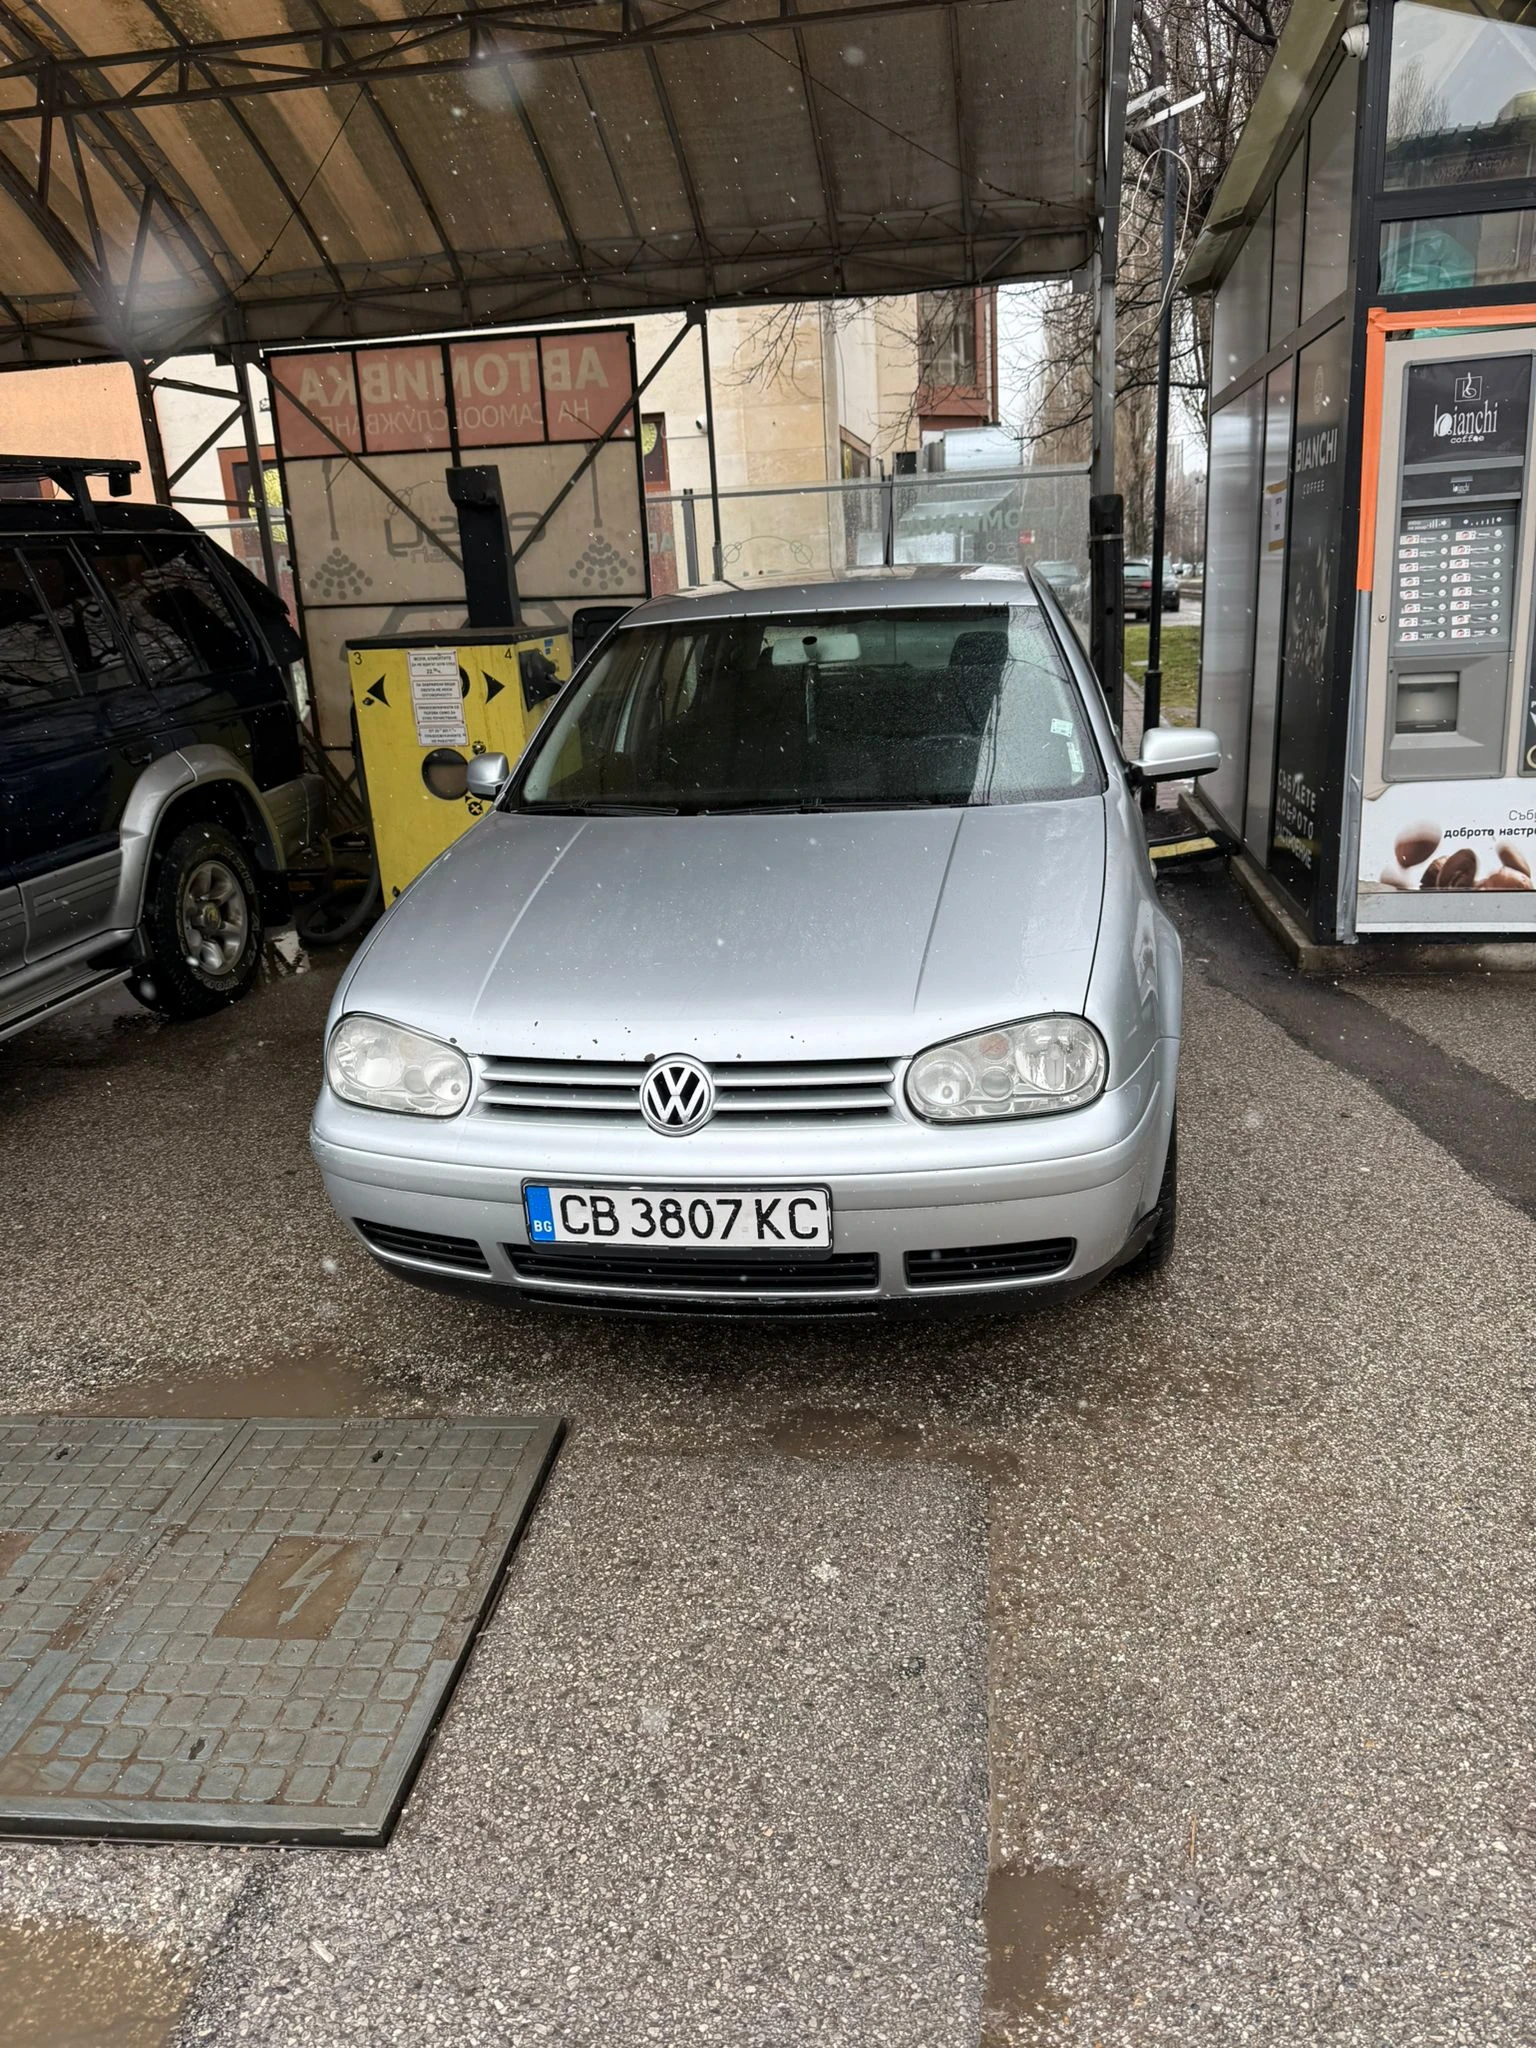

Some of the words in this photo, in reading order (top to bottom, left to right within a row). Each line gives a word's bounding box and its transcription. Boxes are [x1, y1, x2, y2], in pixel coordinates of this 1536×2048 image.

[1433, 400, 1498, 437] bianchi
[1450, 435, 1485, 444] coffee
[1295, 428, 1338, 473] BIANCHI
[354, 651, 363, 666] 3
[504, 648, 512, 660] 4
[1508, 809, 1536, 822] Съб
[1443, 825, 1495, 840] доброто
[1499, 824, 1536, 837] настр
[534, 1219, 553, 1233] BG
[631, 1197, 743, 1240] 3807
